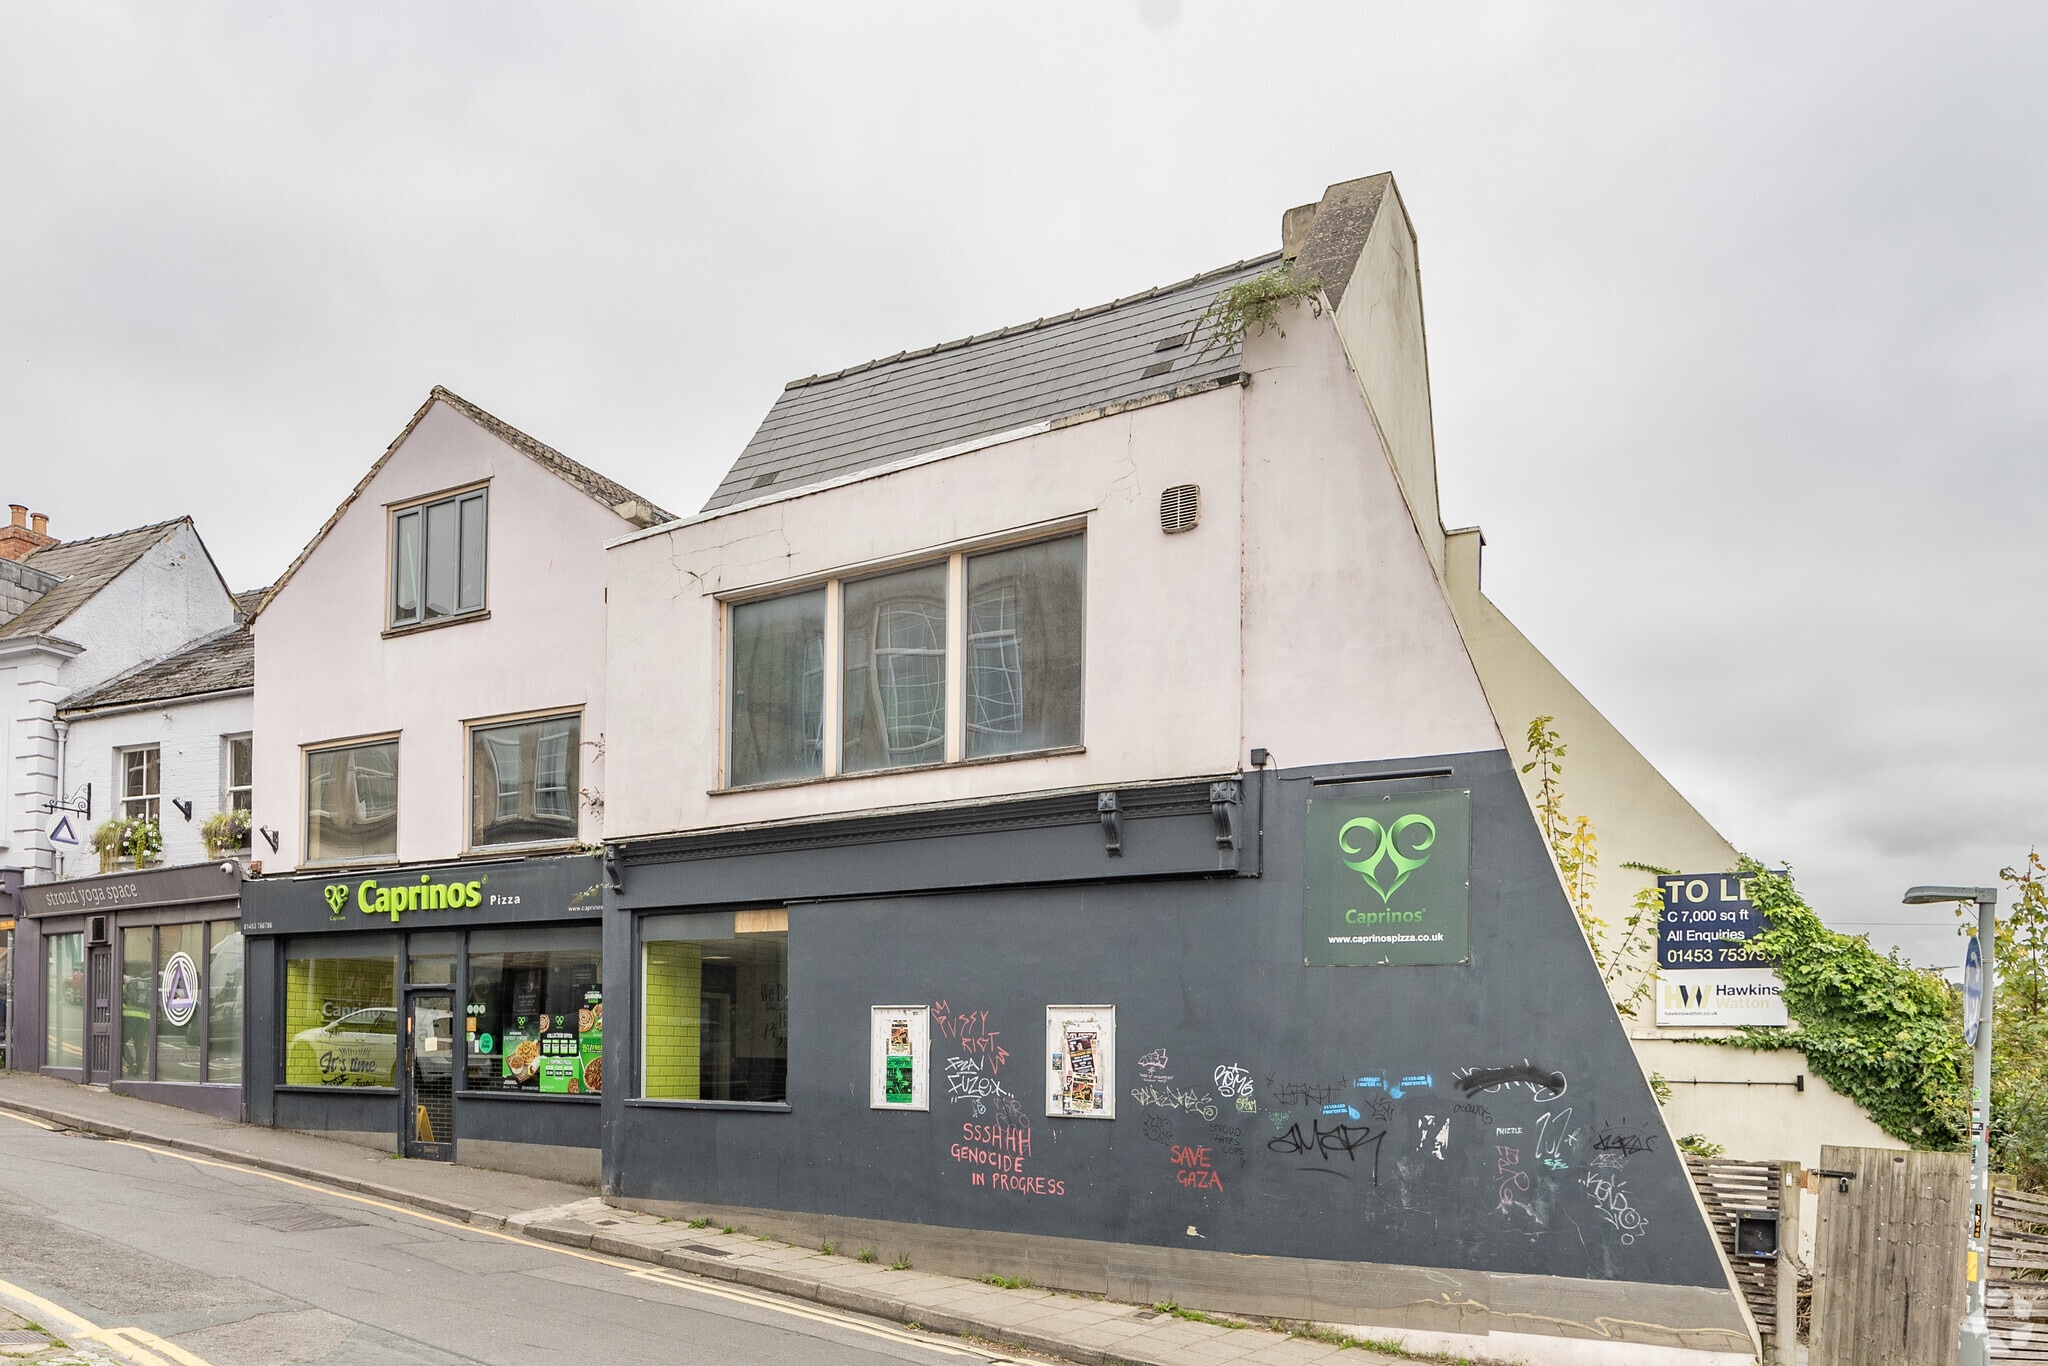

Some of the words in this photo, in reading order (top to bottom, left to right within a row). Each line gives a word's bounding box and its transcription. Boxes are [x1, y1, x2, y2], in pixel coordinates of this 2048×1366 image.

[45, 887, 79, 906] stroud
[78, 887, 106, 907] yoga
[106, 883, 138, 903] space
[357, 874, 483, 922] Caprinos
[490, 894, 521, 906] Pizza
[1665, 879, 1709, 903] TO
[1720, 877, 1753, 902] LE
[1345, 907, 1423, 927] Caprinos
[1667, 911, 1678, 923] C
[1681, 910, 1717, 924] 7,000
[1720, 910, 1736, 923] sq
[1739, 908, 1749, 920] ft
[1327, 932, 1444, 945] www.caprinospizza.co.uk
[1667, 930, 1682, 942] All
[1687, 928, 1745, 944] Enquiries
[1667, 949, 1713, 963] 01453
[1715, 983, 1779, 996] Hawkins
[1715, 997, 1770, 1009] Watton
[963, 1122, 1031, 1157] SSSHHH
[1209, 1123, 1241, 1137] STROUD
[951, 1143, 1026, 1173] GENOCIDE
[1170, 1145, 1212, 1168] SAVE
[972, 1172, 985, 1186] IN
[992, 1172, 1065, 1196] PROGRESS
[1177, 1169, 1223, 1192] GAZA
